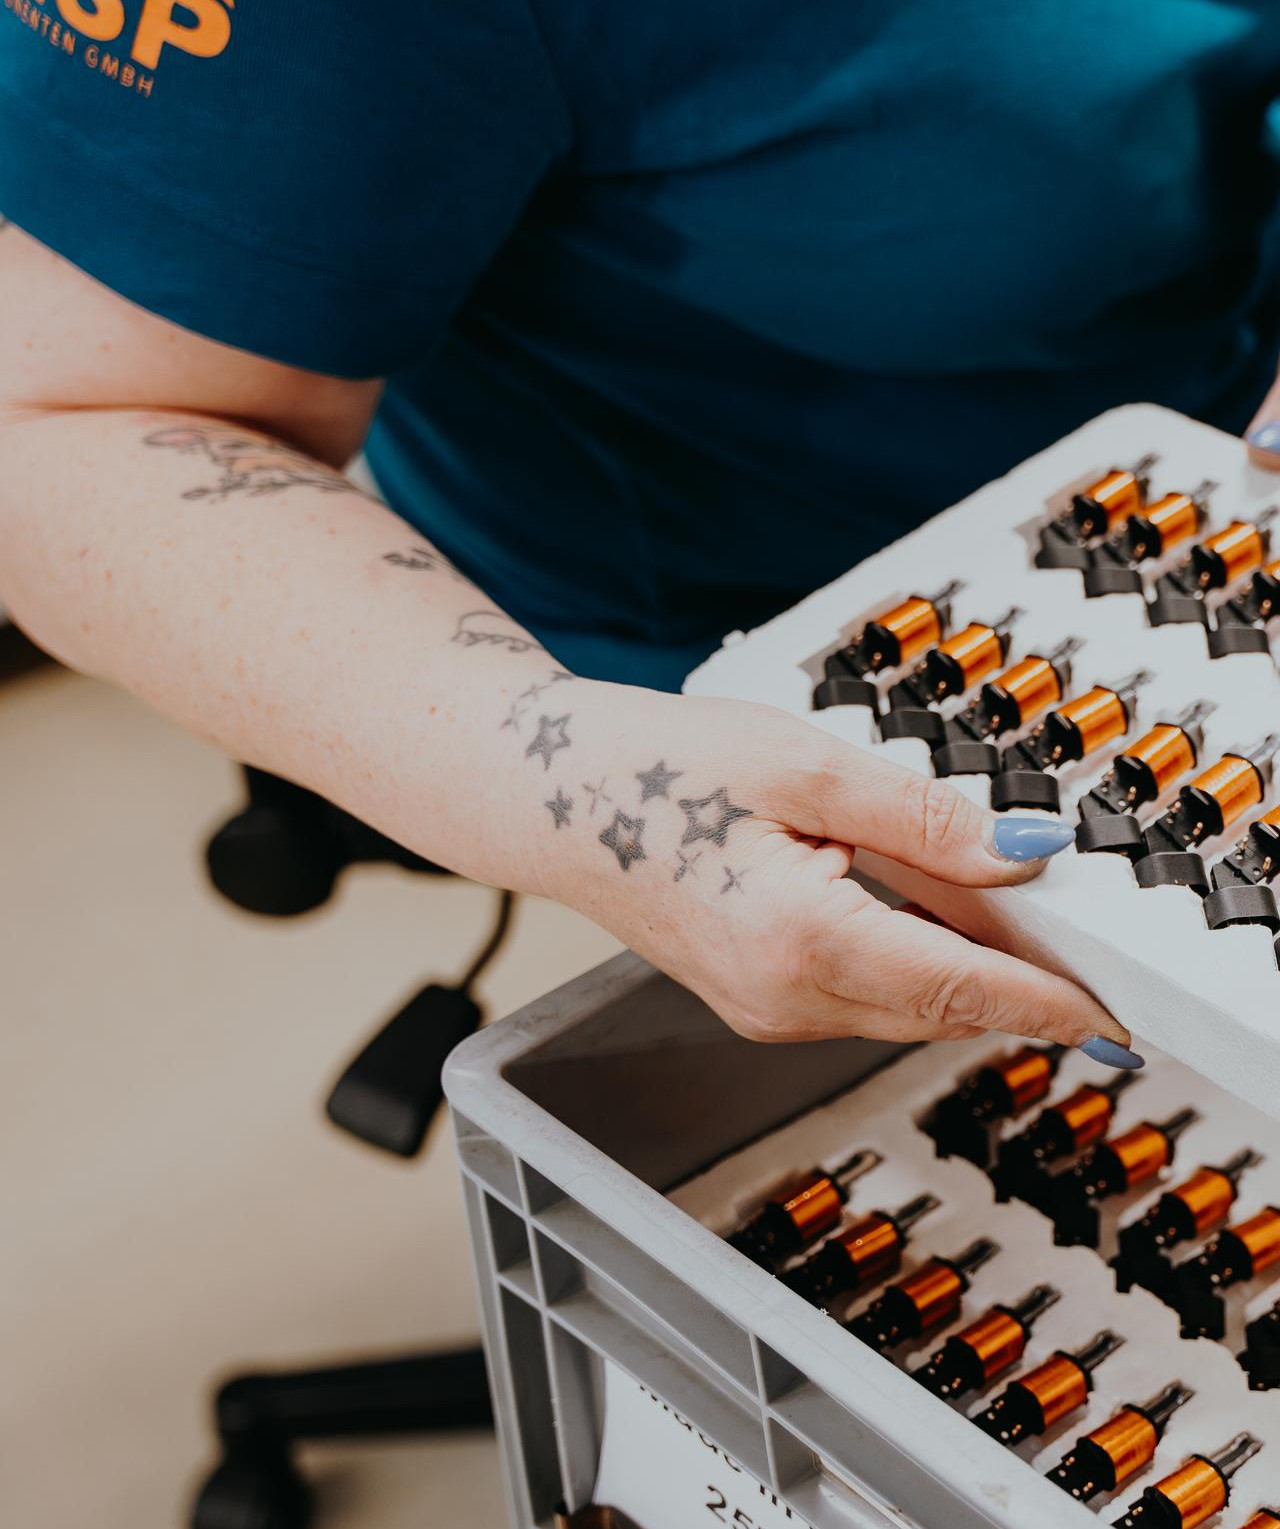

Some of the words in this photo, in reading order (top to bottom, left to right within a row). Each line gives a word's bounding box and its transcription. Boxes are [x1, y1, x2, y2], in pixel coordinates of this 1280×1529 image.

[31, 0, 232, 70] SP
[84, 44, 155, 97] GMBH
[706, 1485, 761, 1529] 25
